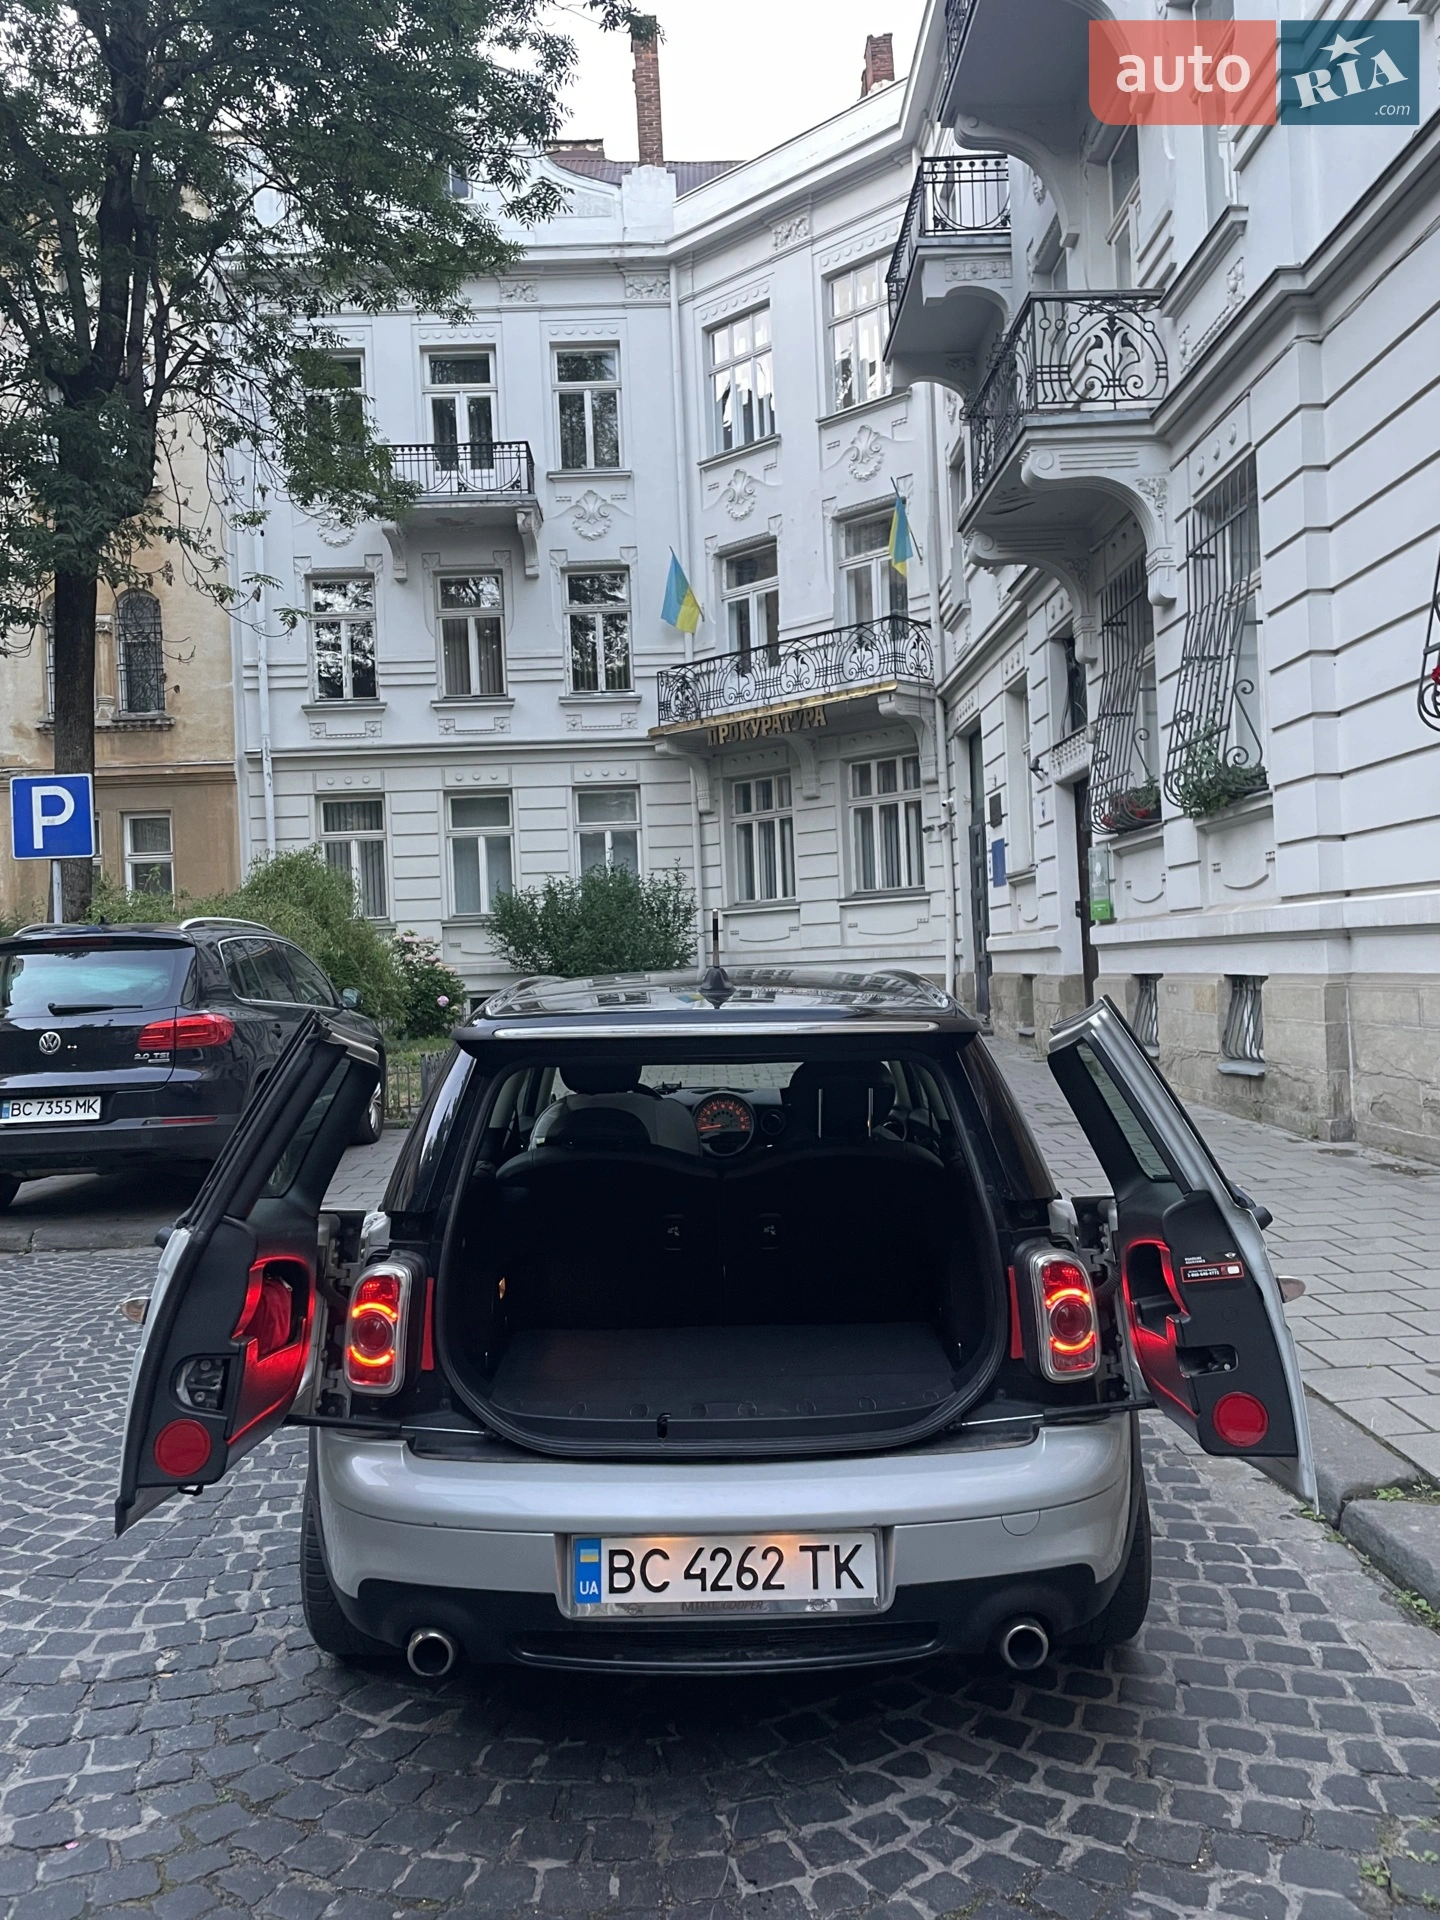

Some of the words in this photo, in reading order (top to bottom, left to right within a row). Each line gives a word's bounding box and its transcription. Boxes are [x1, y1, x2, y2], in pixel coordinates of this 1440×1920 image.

[707, 705, 828, 746] ПРОКУРАТУРА
[31, 785, 75, 850] P
[11, 1102, 33, 1117] BC
[36, 1100, 72, 1116] 7355
[75, 1098, 99, 1114] MK
[579, 1580, 599, 1595] UA
[608, 1548, 670, 1594] BC
[684, 1546, 785, 1592] 4262
[799, 1544, 864, 1590] TK
